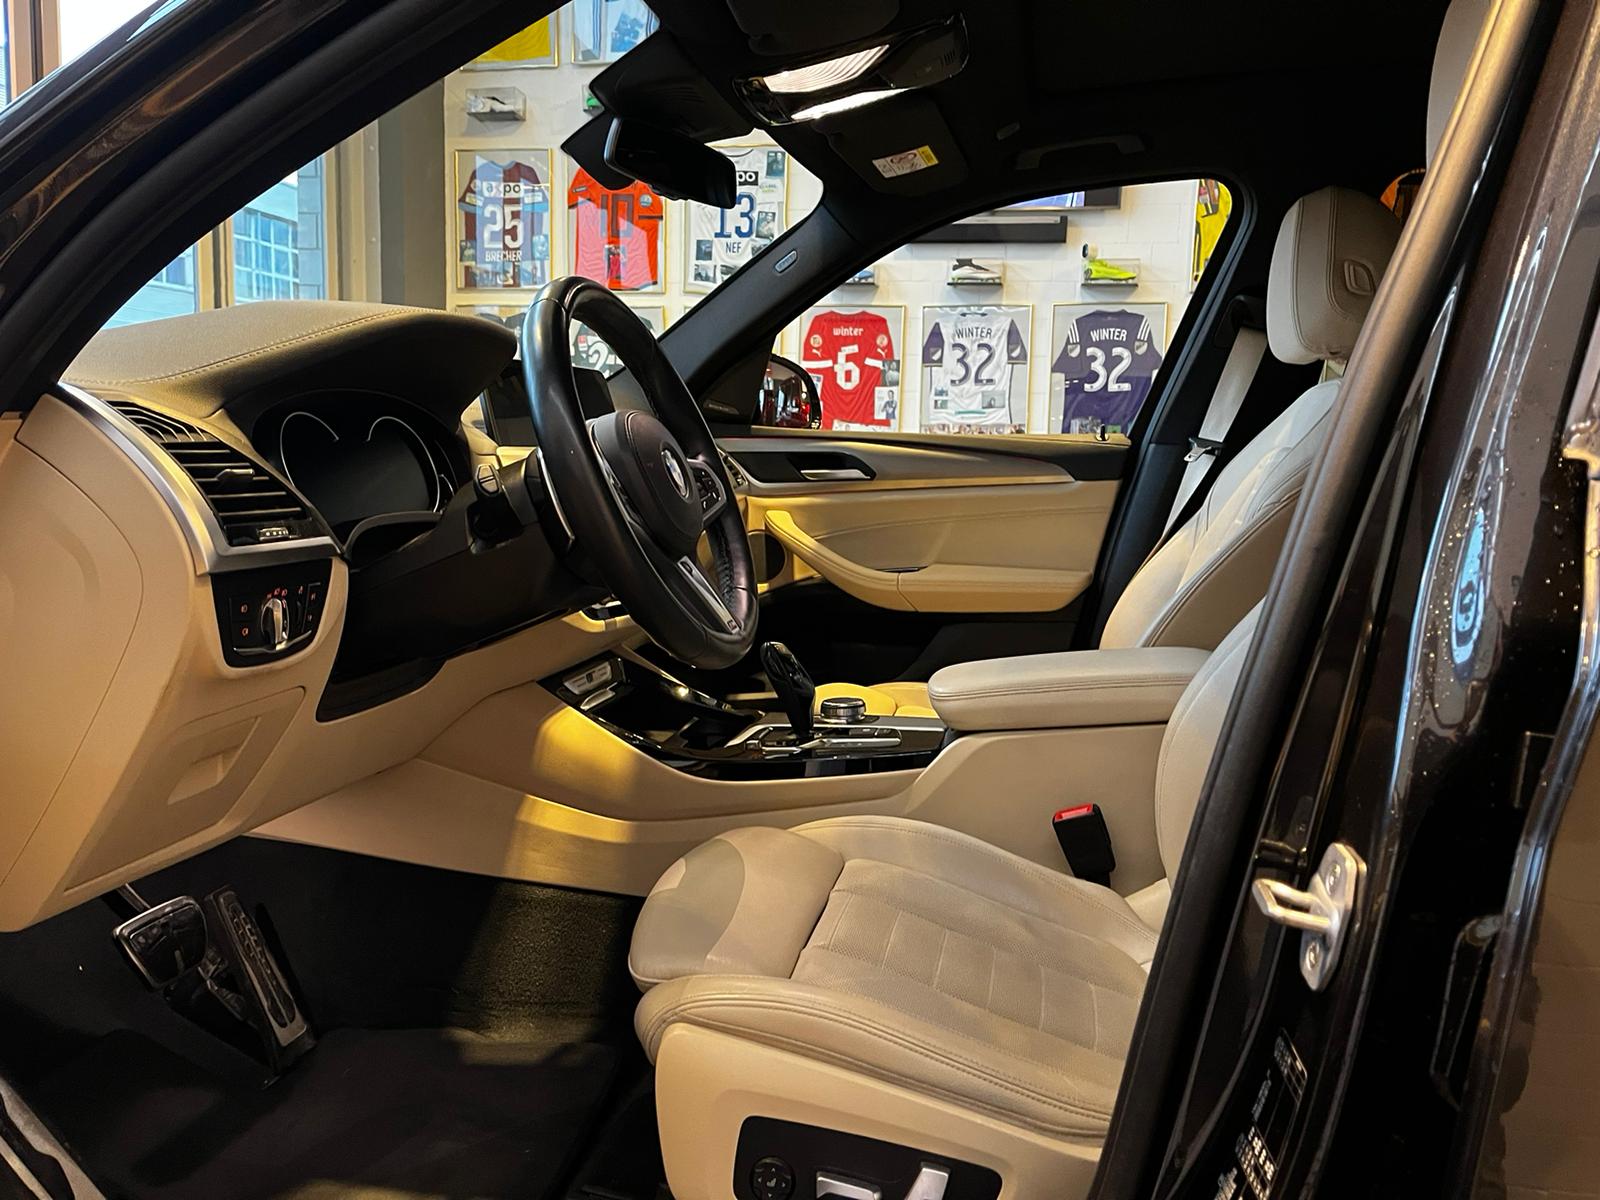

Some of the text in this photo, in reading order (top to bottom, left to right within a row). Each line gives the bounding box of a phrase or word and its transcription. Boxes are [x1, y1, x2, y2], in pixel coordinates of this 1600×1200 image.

[736, 171, 756, 186] po
[714, 191, 756, 239] 13
[483, 203, 524, 249] 25
[725, 241, 742, 254] NEF
[485, 250, 523, 262] BRECHER
[832, 326, 864, 336] winter
[955, 327, 993, 339] WINTER
[1090, 327, 1128, 342] WINTER
[833, 344, 860, 390] 6
[950, 343, 996, 387] 32
[1083, 347, 1132, 392] 32
